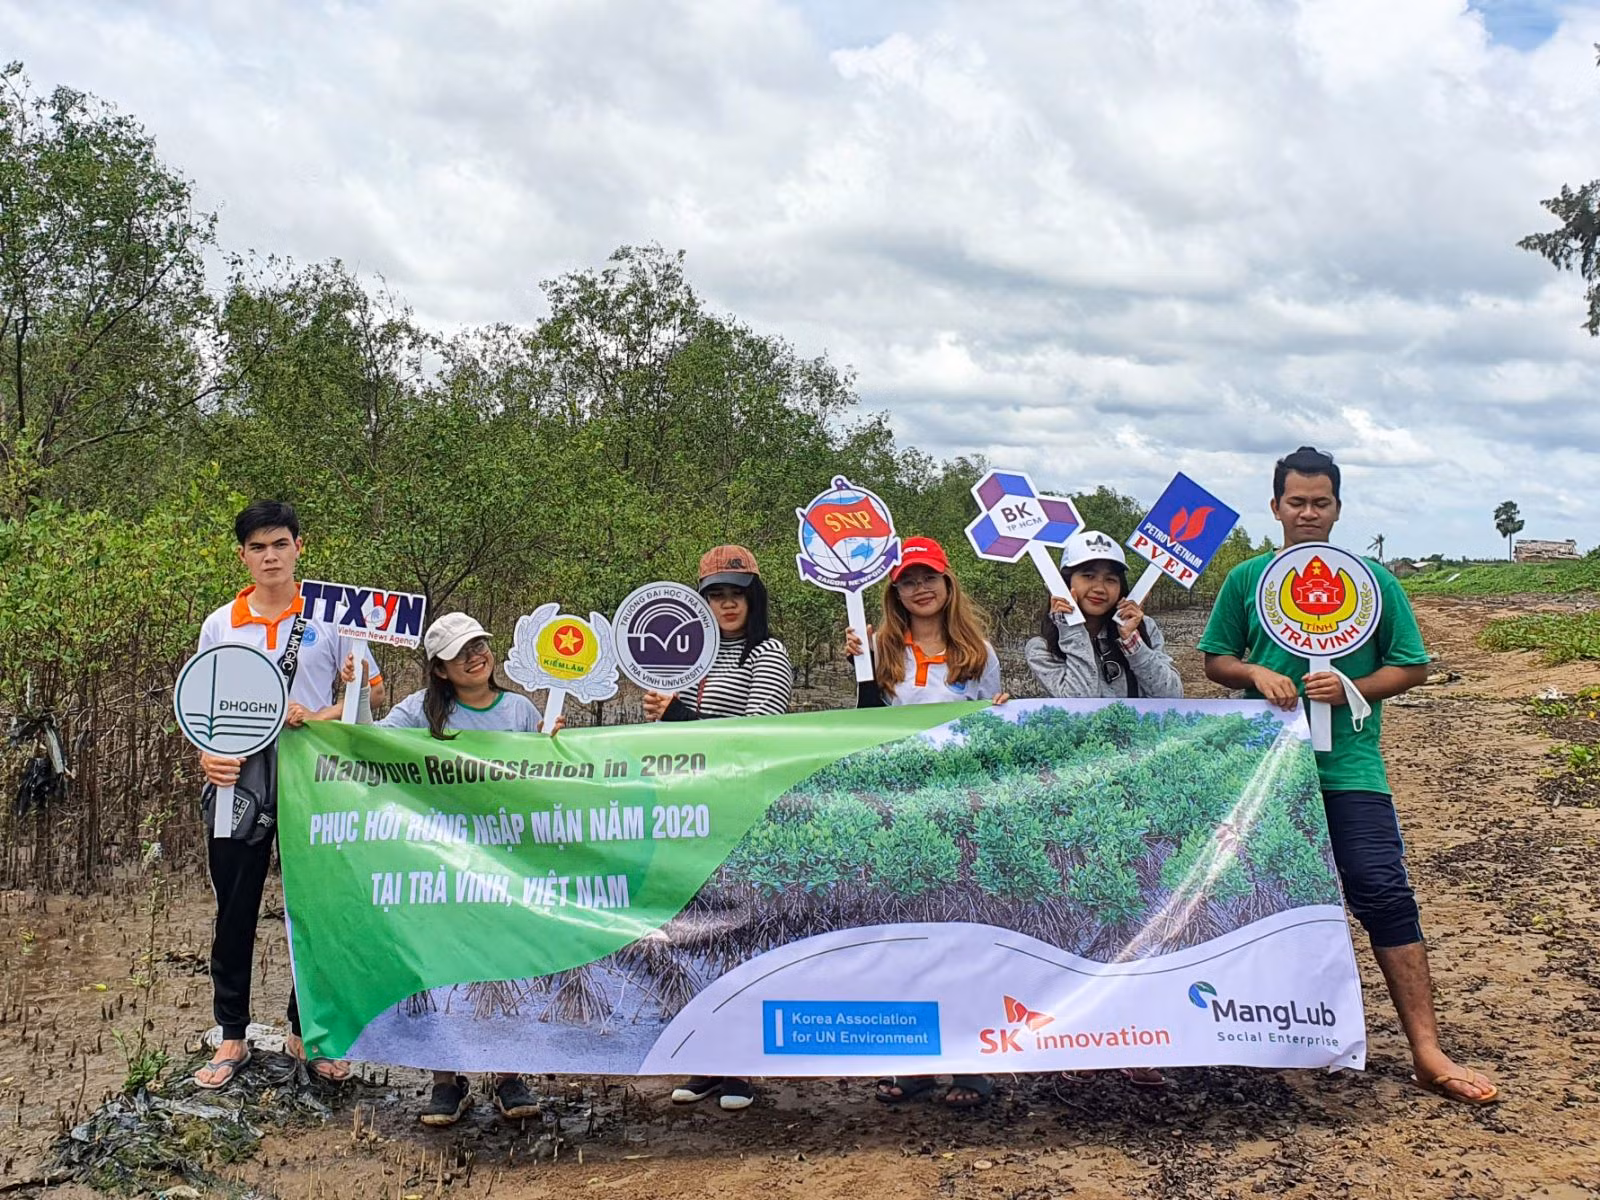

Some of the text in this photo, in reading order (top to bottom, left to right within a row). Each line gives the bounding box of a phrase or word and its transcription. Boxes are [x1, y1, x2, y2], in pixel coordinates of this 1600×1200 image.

[824, 510, 873, 532] SNP
[1000, 502, 1033, 523] BK
[1132, 534, 1193, 581] PVEP
[1143, 522, 1203, 568] PETROVIETNAM
[816, 564, 887, 587] SAIGON NEWPORT
[301, 581, 424, 636] TTXVN
[698, 608, 711, 629] VINH
[338, 626, 418, 647] Vietnam News Agency
[1280, 623, 1360, 650] TRÀ VINH
[282, 634, 302, 671] MAGIC
[642, 675, 660, 686] VINH
[661, 664, 704, 687] UNIVERSITY
[219, 700, 277, 713] ĐHQGHN
[314, 753, 706, 787] Mangrove Reforestation in 2020
[310, 810, 360, 850] PHỤC
[472, 807, 525, 852] NGẬP
[590, 800, 645, 841] NĂM
[652, 804, 711, 839] 2020
[371, 871, 402, 913] TẠI
[408, 864, 447, 904] TRÀ
[576, 874, 630, 909] NAM
[791, 1012, 917, 1026] Korea Association
[1212, 999, 1336, 1031] MangLub
[792, 1030, 929, 1045] for UN Environment
[979, 1025, 1171, 1054] SK innovation
[1217, 1032, 1340, 1048] Social Enterprise
